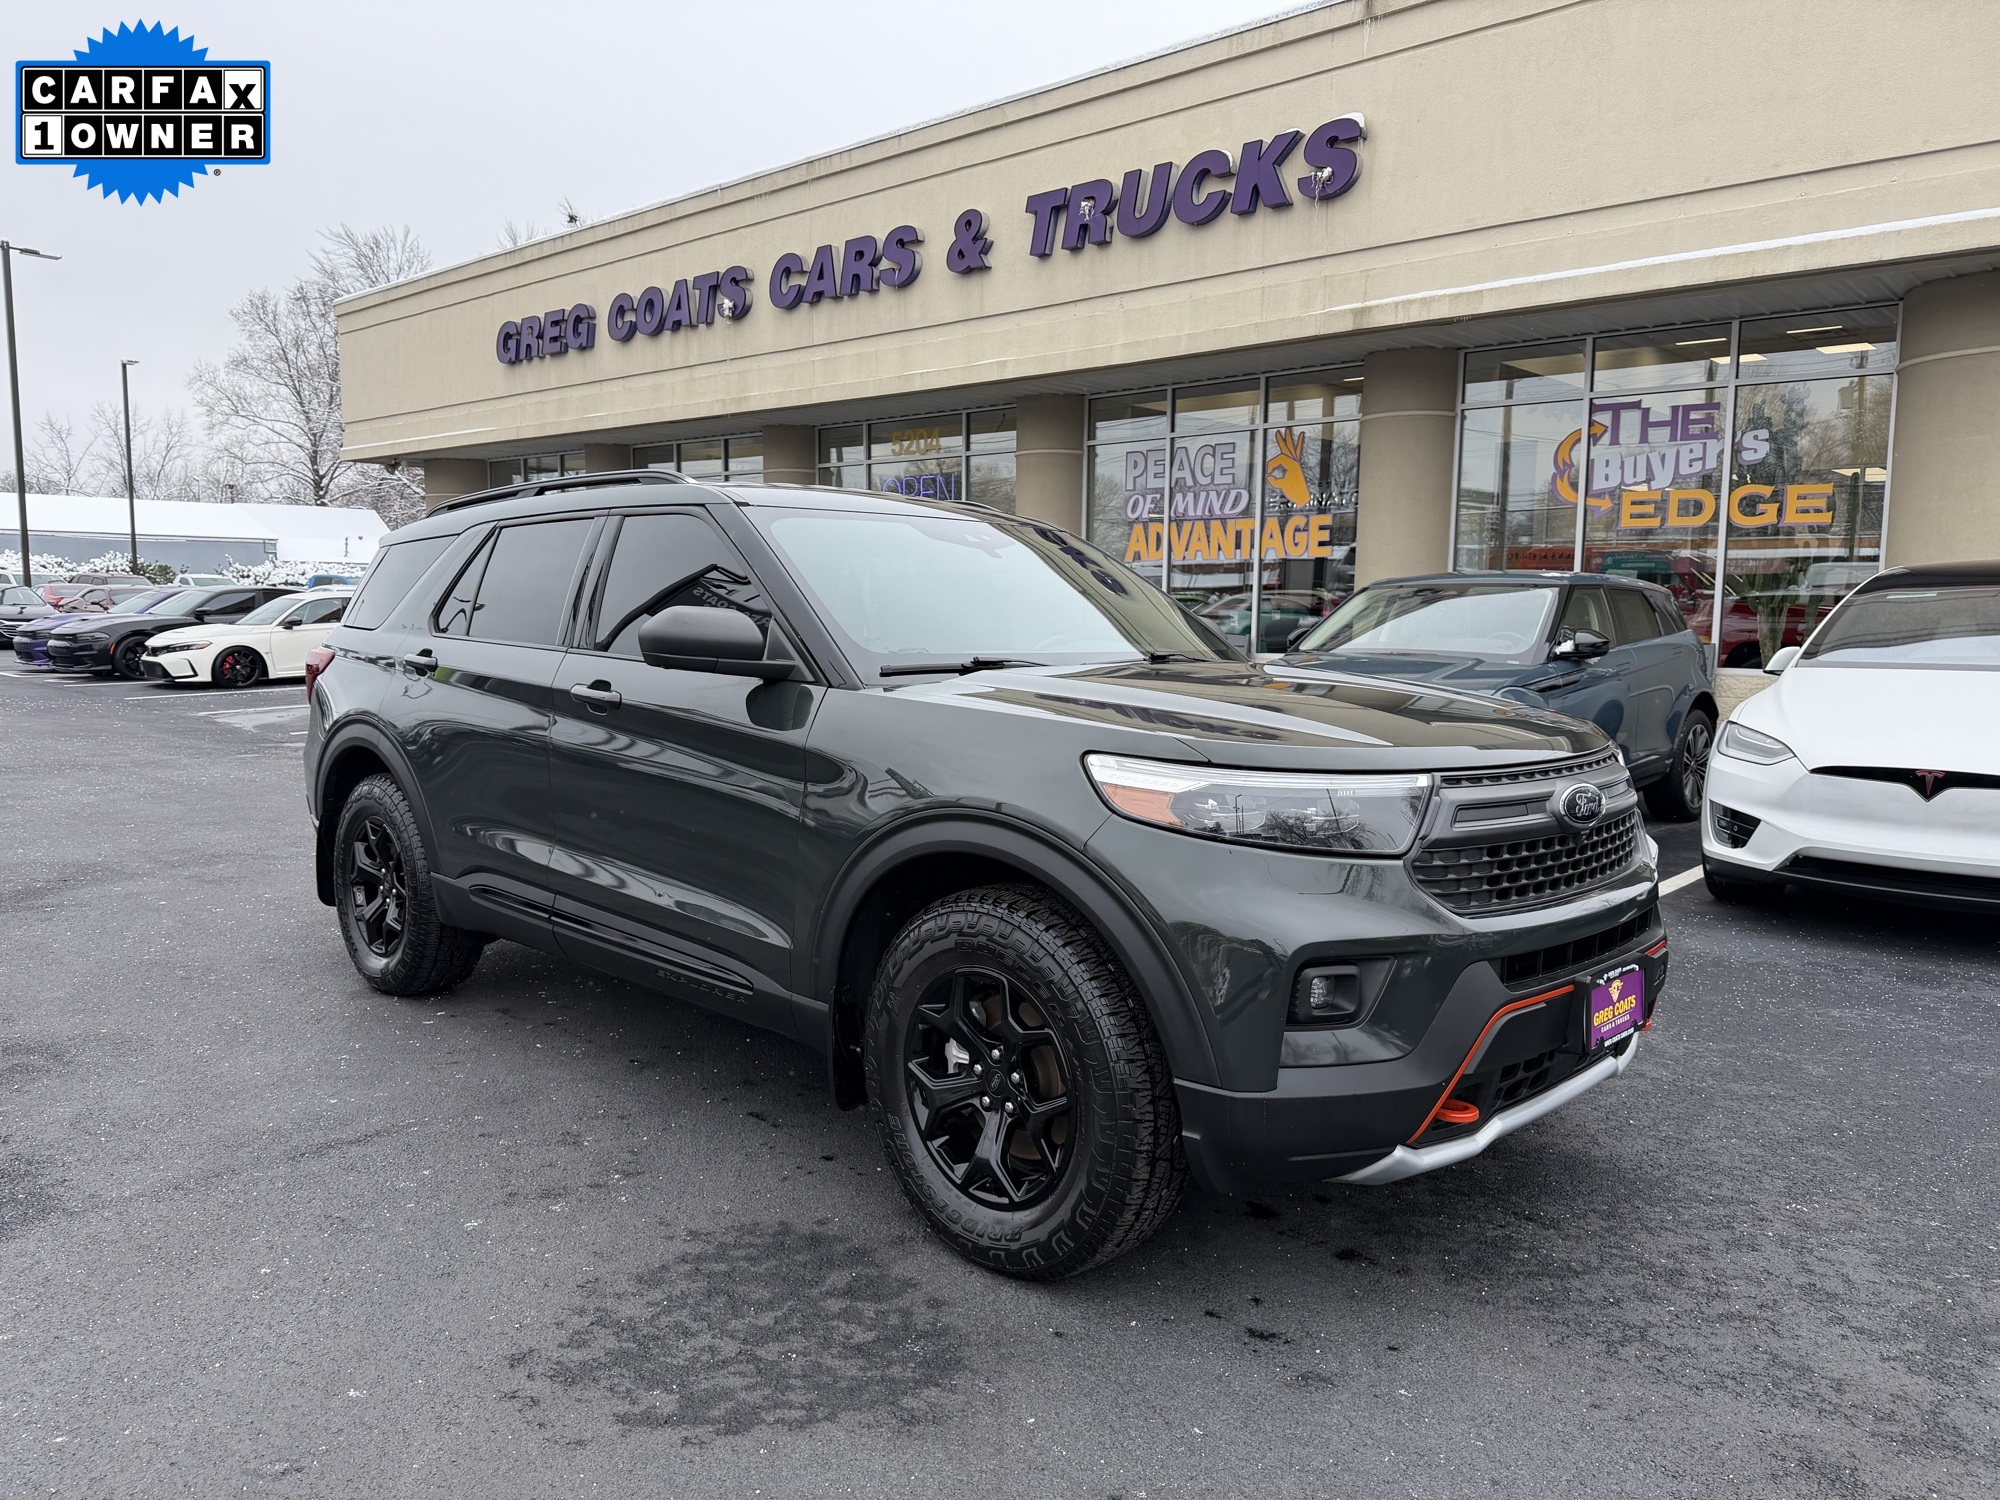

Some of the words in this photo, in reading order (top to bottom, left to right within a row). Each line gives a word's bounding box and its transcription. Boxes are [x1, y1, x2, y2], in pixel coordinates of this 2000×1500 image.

[496, 303, 595, 364] GREG
[607, 265, 755, 342] COATS
[769, 225, 926, 310] CARS
[946, 209, 994, 274] &
[1025, 114, 1368, 258] TRUCKS
[890, 427, 941, 457] 5204
[1591, 398, 1721, 446] THE
[882, 473, 955, 500] OPEN
[1125, 442, 1236, 492] PEACE
[1125, 493, 1162, 522] OF
[1170, 489, 1250, 520] MIND
[1617, 482, 1834, 530] EDGE
[1124, 514, 1334, 563] ADVANTAGE
[1575, 792, 1600, 817] Ford
[1593, 1005, 1613, 1026] GREG
[1614, 995, 1636, 1017] COATS
[887, 1112, 1024, 1242] BRIDGESTONE
